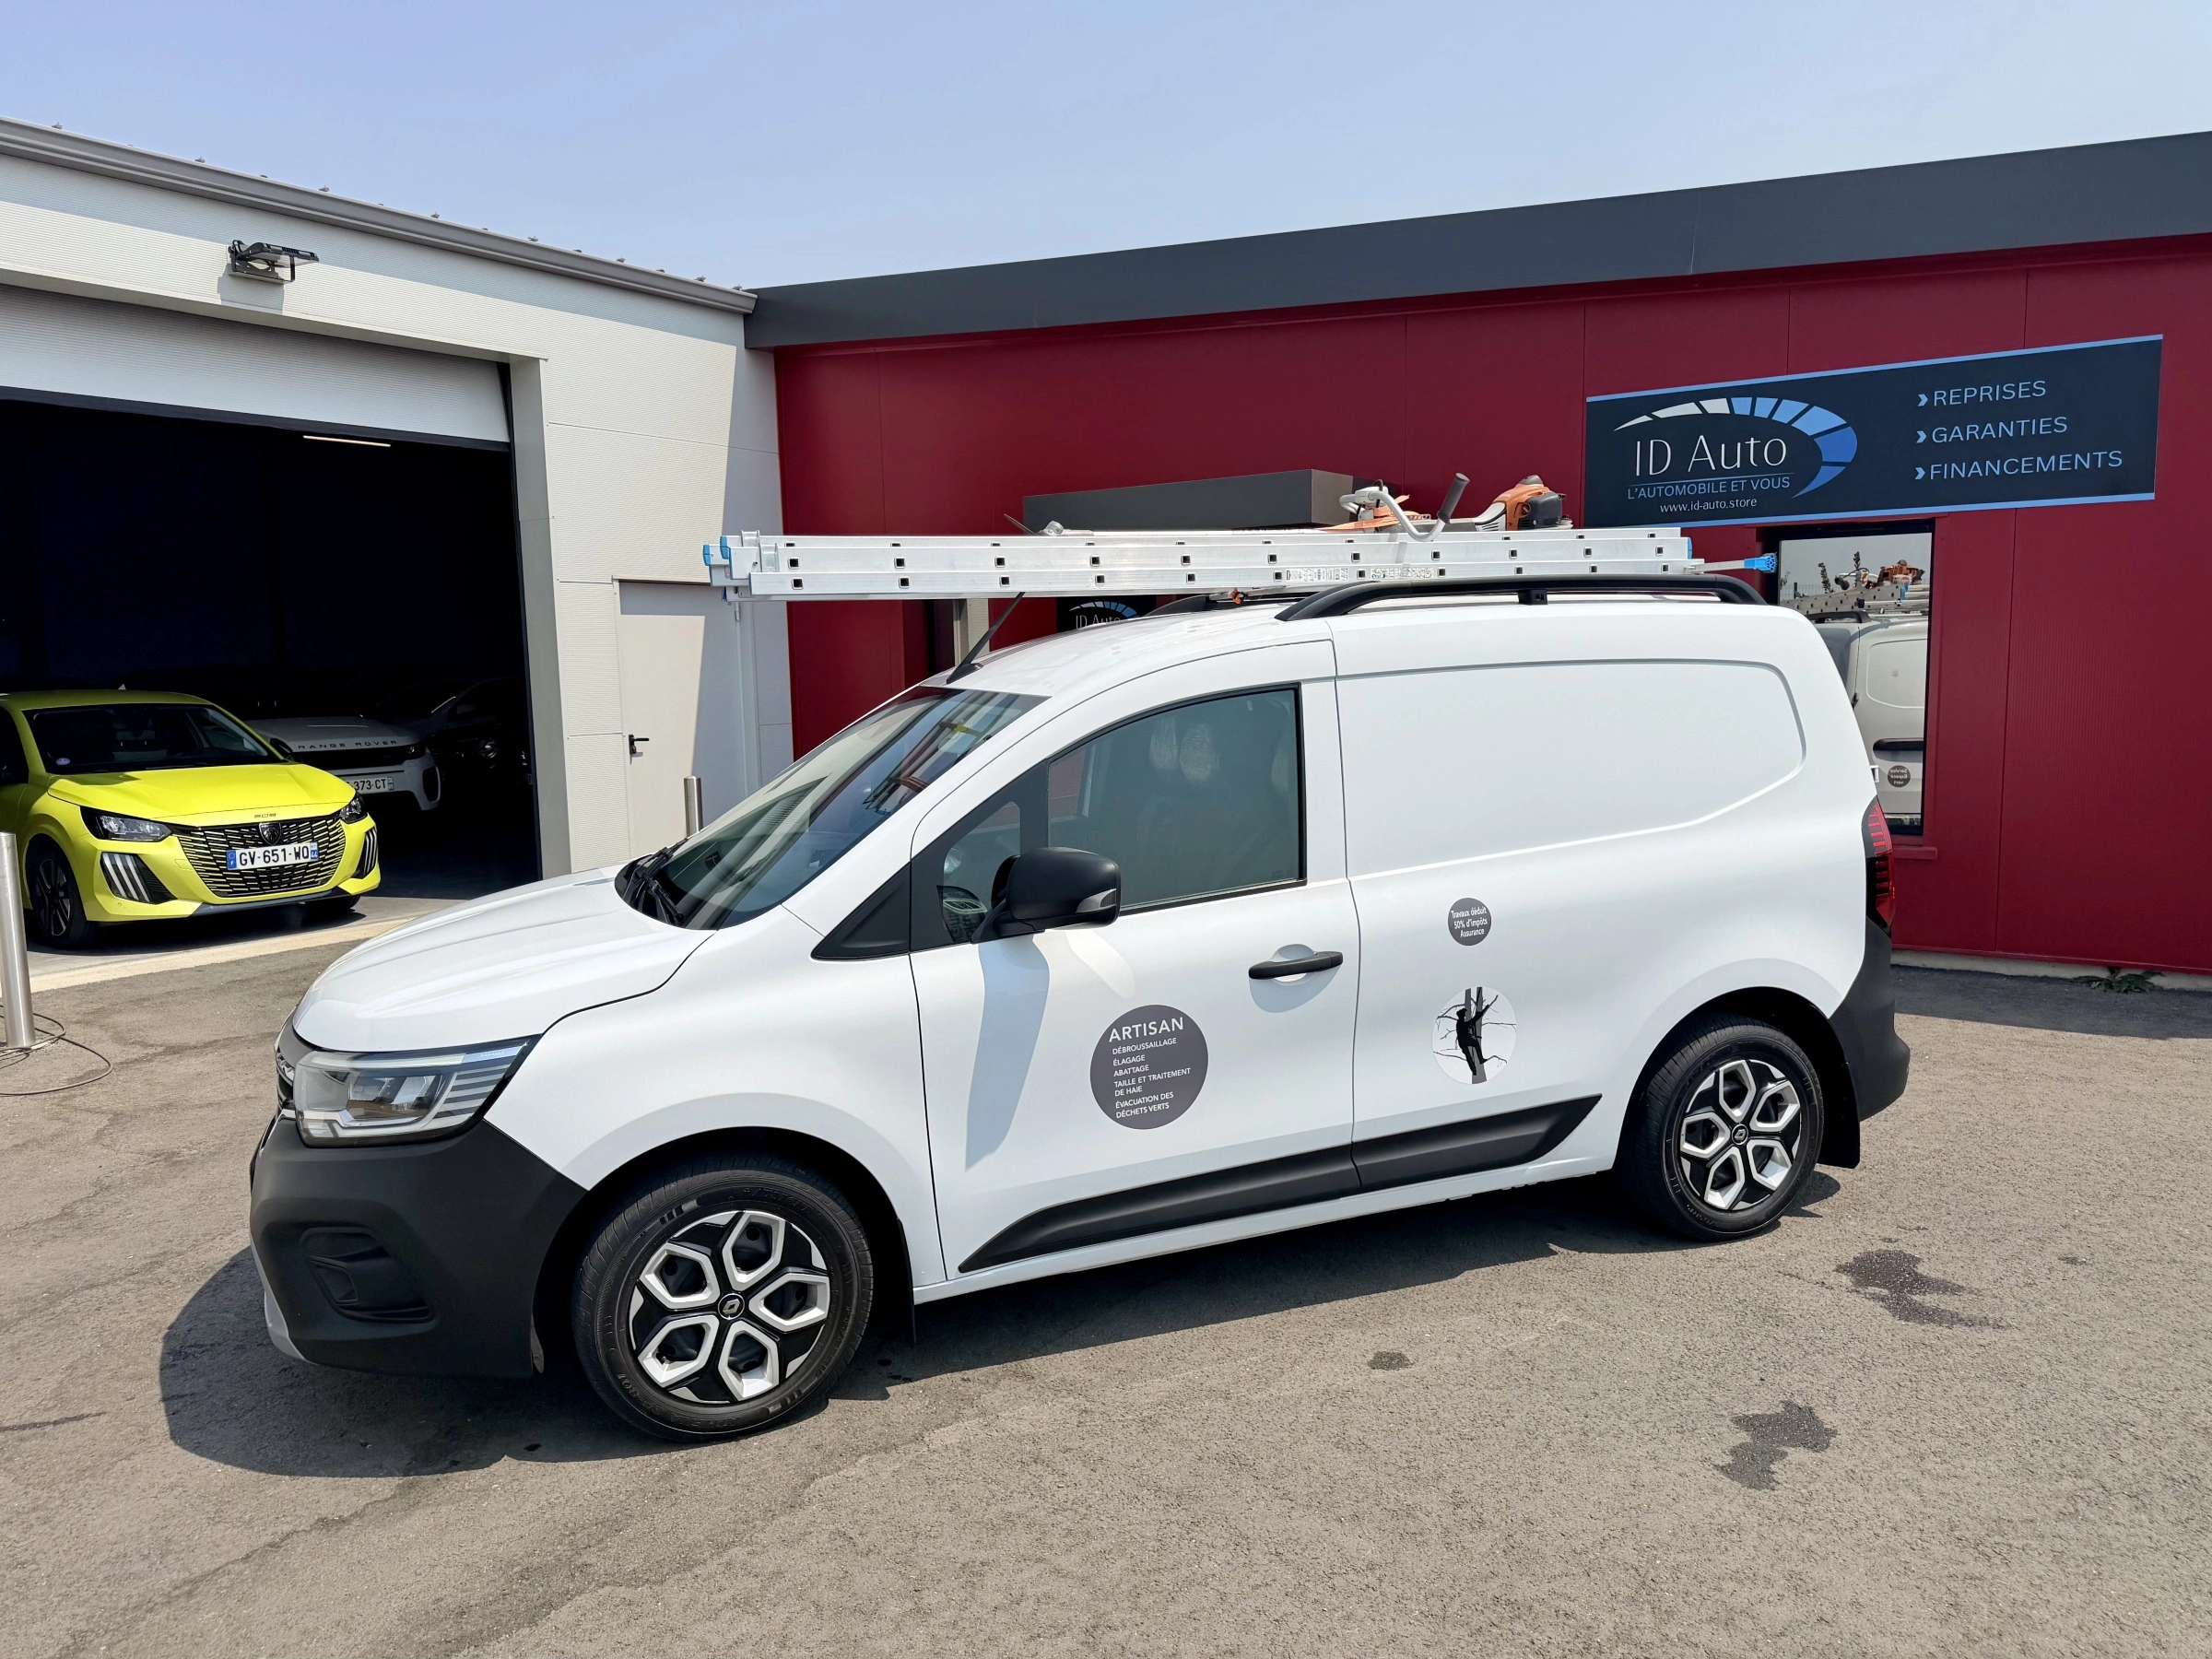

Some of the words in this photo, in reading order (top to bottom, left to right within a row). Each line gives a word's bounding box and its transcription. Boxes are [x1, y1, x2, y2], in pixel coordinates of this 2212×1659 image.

[1934, 380, 2046, 406] REPRISES
[1932, 417, 2068, 443] GARANTIES
[1635, 439, 1672, 477] ID
[1688, 435, 1787, 472] Auto
[1930, 450, 2123, 480] FINANCEMENTS
[1628, 481, 1727, 500] L'AUTOMOBILE
[1731, 479, 1747, 492] ET
[1751, 477, 1791, 490] VOUS
[1660, 497, 1758, 513] www.id-auto.store
[239, 845, 310, 866] GV-651-WQ
[1451, 910, 1470, 919] Travaux
[1453, 920, 1465, 929] 50%
[1466, 917, 1488, 928] d'impôts
[1460, 928, 1485, 938] Assurance
[1108, 1017, 1183, 1042] ARTISAN
[1112, 1037, 1177, 1054] DÉBROUSSAILLAGE
[1112, 1054, 1146, 1066] ÉLAGAGE
[1113, 1065, 1149, 1077] ABATTAGE
[1114, 1077, 1136, 1088] TAILLE
[1137, 1076, 1147, 1084] ET
[1147, 1067, 1191, 1082] TRAITEMENT
[1114, 1088, 1124, 1097] DE
[1126, 1085, 1143, 1095] HAIE
[1115, 1094, 1159, 1109] ÉVACUATION
[1160, 1091, 1174, 1100] DES
[1116, 1106, 1147, 1119] DÉCHETS
[1148, 1102, 1170, 1112] VERTS
